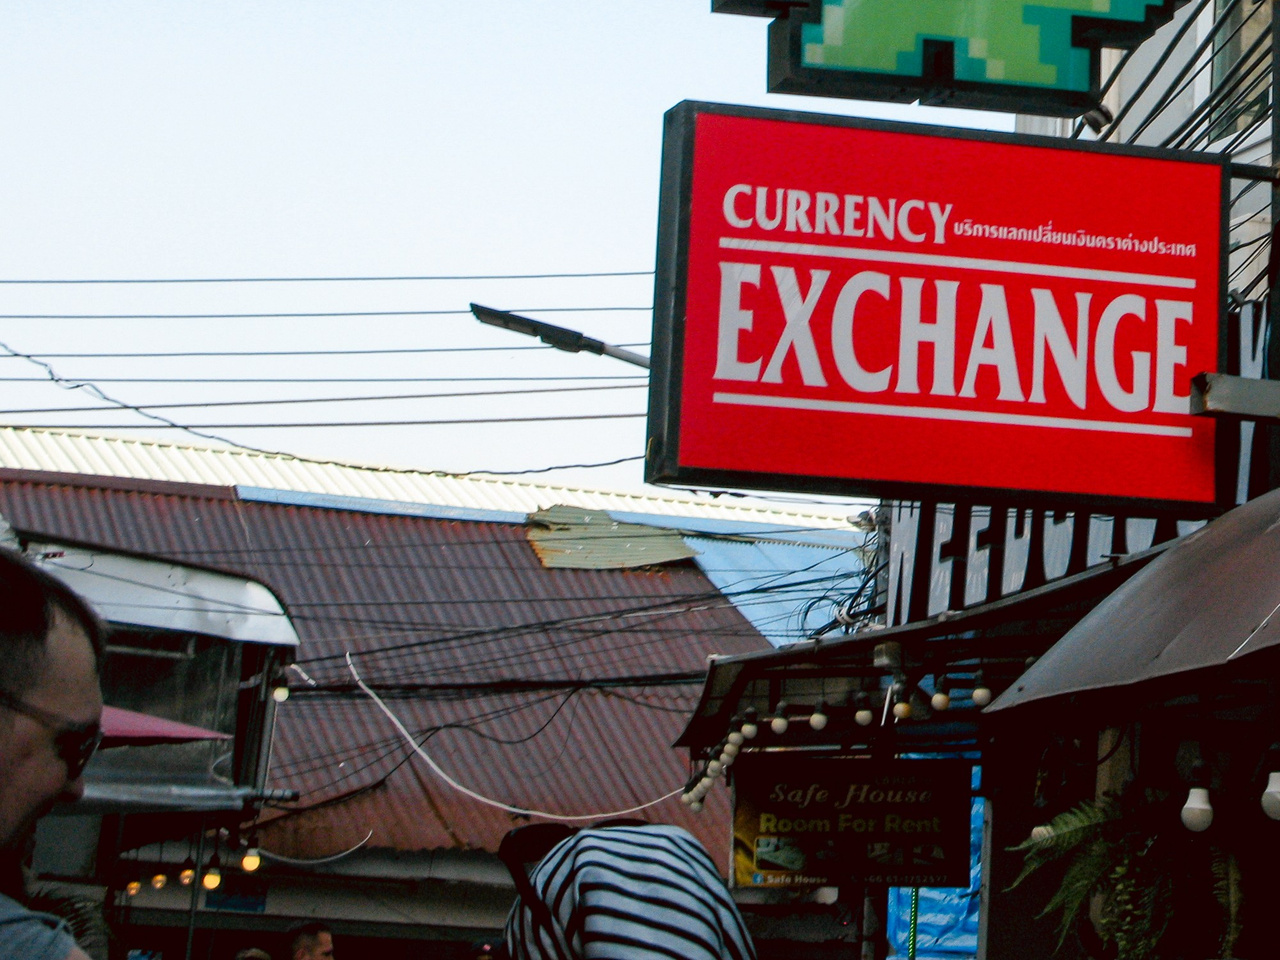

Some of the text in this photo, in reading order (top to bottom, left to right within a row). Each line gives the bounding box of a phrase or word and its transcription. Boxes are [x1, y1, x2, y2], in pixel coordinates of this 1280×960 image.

[722, 183, 953, 245] CURRENCY
[712, 262, 1193, 415] EXCHANGE
[769, 783, 933, 809] Safe House
[759, 812, 943, 833] Room For Rent
[767, 874, 828, 884] Safe House
